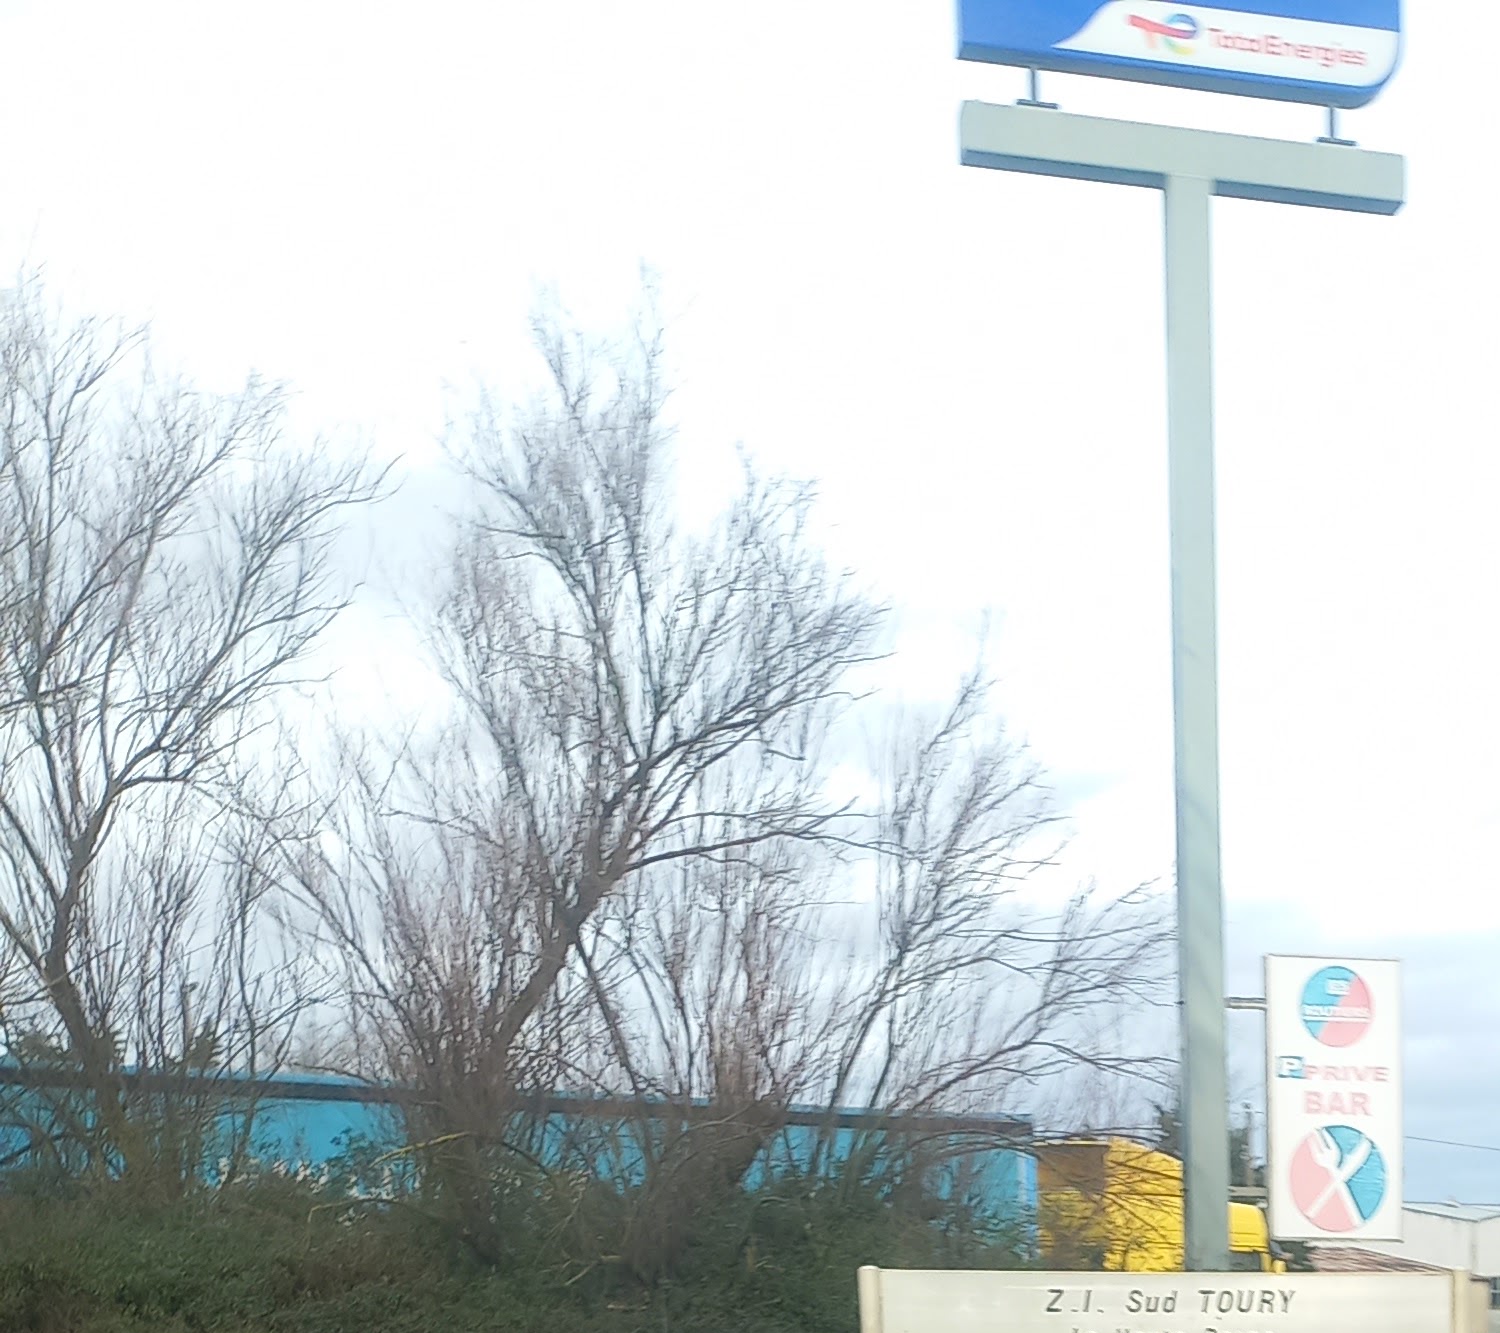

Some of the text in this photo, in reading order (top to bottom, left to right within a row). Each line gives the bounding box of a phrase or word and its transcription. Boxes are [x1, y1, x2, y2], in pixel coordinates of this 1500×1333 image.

[1304, 1091, 1373, 1116] BAR
[1126, 1290, 1177, 1313] Sud
[1198, 1288, 1297, 1313] TOURY
